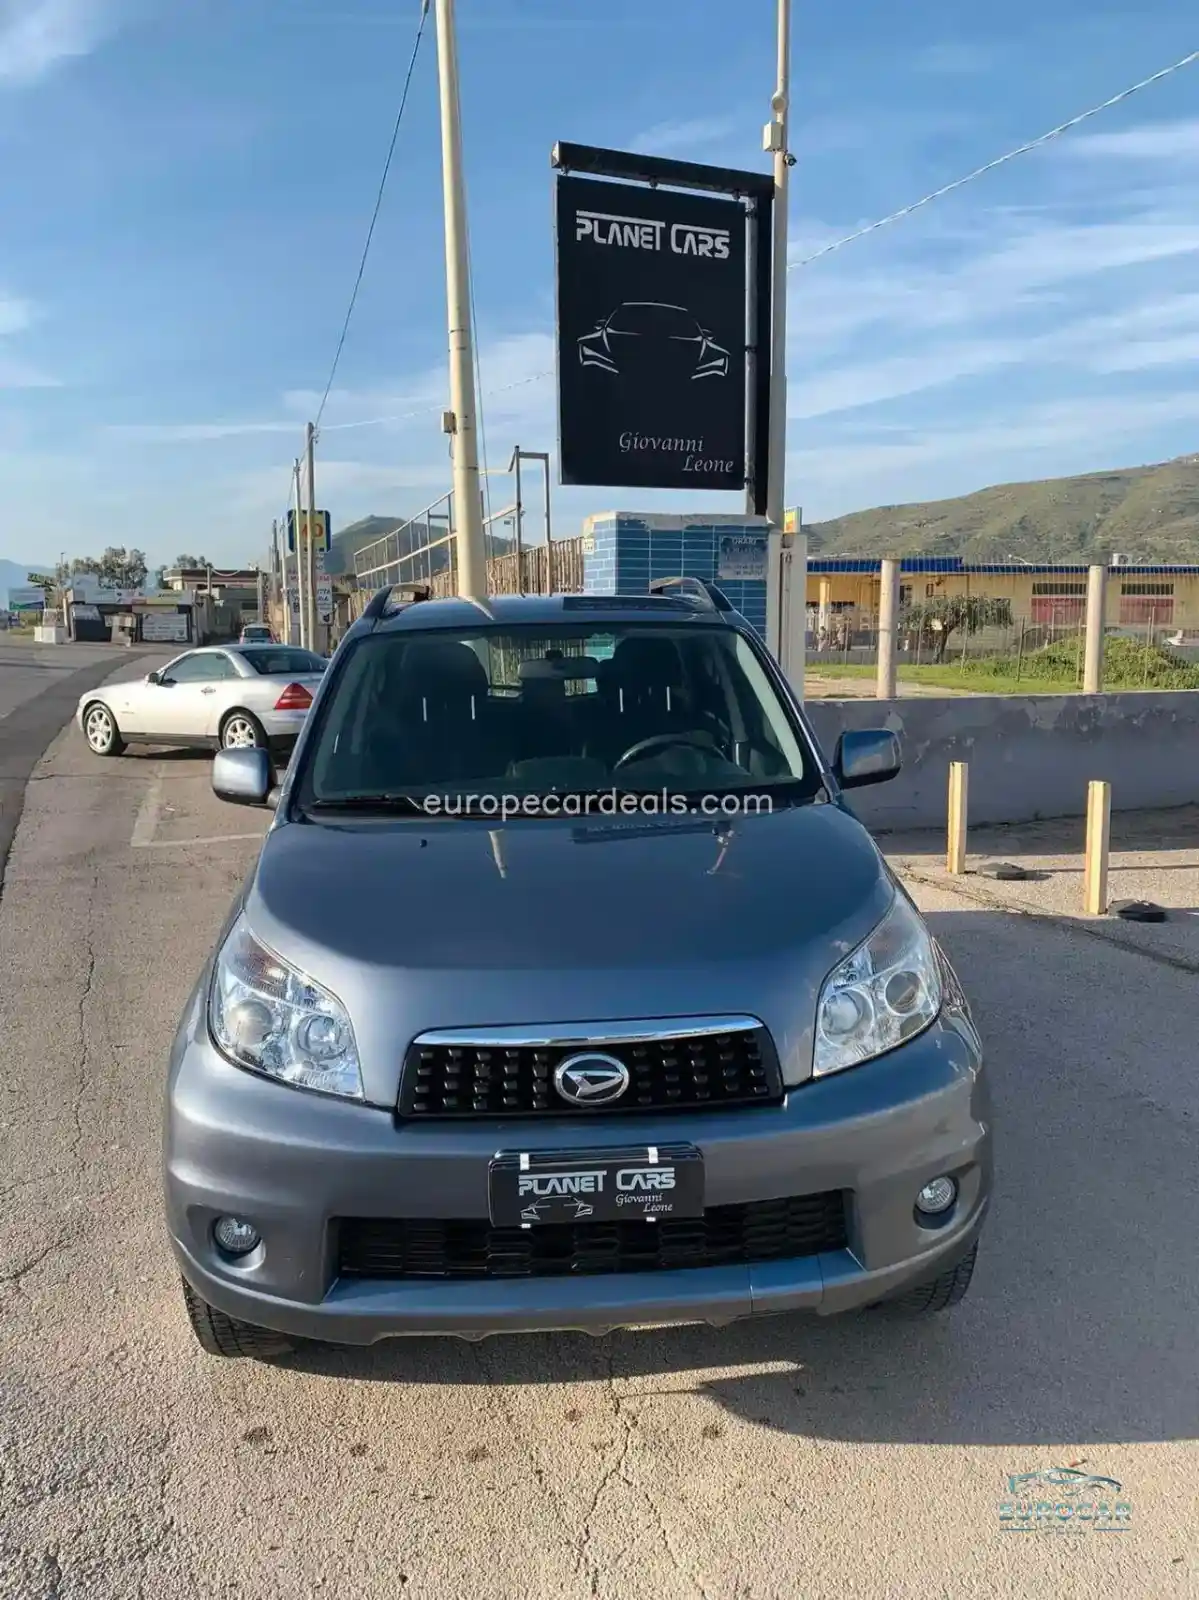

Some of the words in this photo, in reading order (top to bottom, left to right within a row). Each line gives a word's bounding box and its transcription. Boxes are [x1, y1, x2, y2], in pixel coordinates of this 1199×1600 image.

[576, 210, 666, 251] PLANET
[671, 223, 730, 259] CARS
[619, 431, 705, 453] Giovanni
[682, 454, 734, 473] Leone
[518, 1170, 607, 1196] PLANET
[616, 1167, 676, 1191] CARS
[615, 1192, 663, 1207] Giovanni
[643, 1202, 673, 1213] Leone
